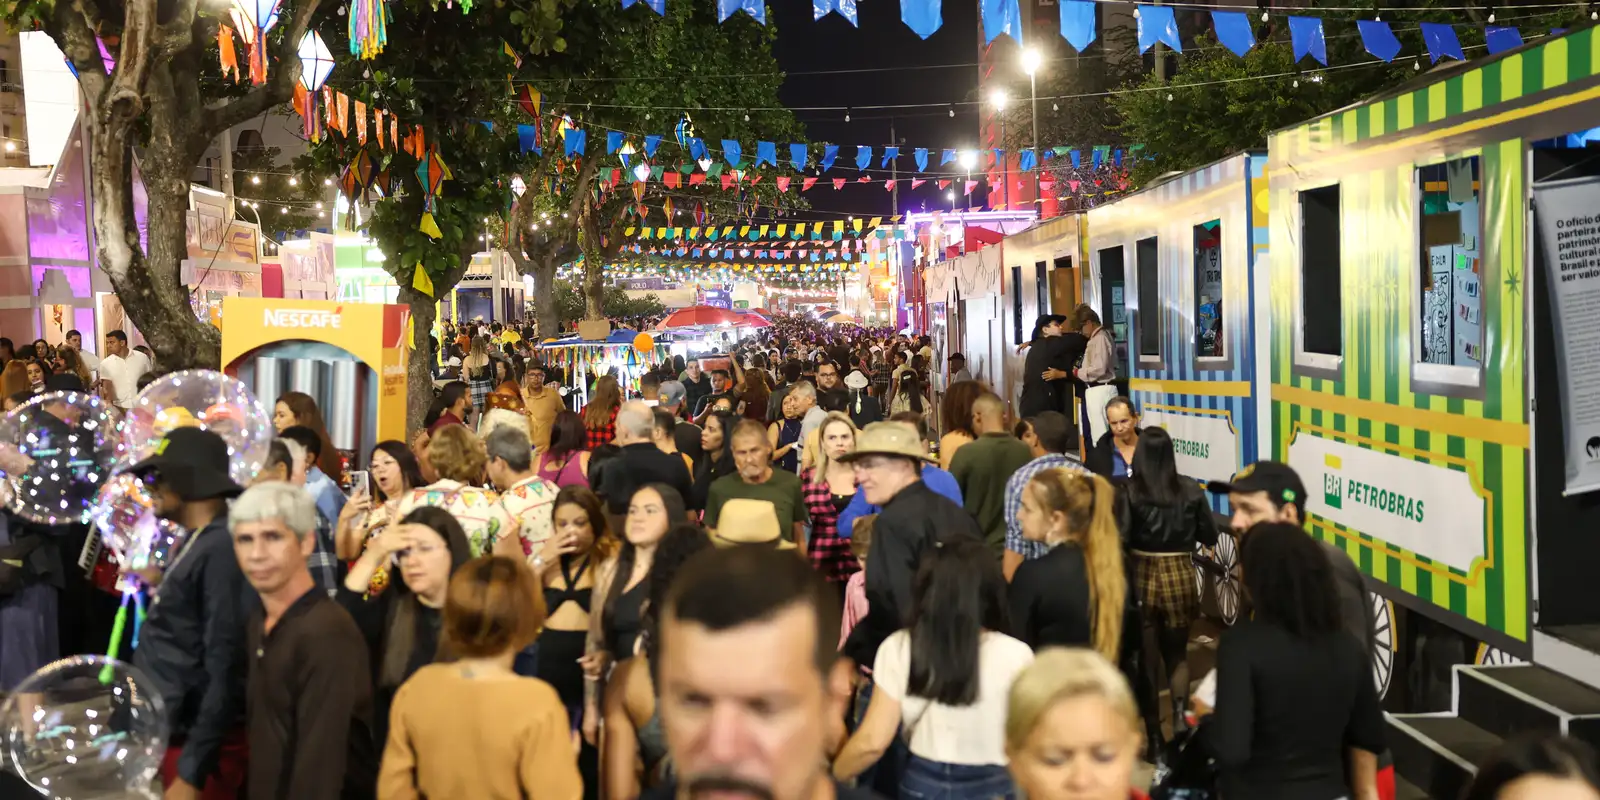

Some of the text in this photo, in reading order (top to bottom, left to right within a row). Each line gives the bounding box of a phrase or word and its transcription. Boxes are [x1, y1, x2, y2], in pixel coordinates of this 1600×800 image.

[1557, 219, 1565, 228] O
[1566, 216, 1593, 227] ofício
[1558, 227, 1596, 241] parteira
[1560, 247, 1597, 260] cultural
[1561, 259, 1588, 271] Brasil
[1562, 274, 1576, 282] ser
[264, 306, 343, 328] NESCAFÉ
[1324, 473, 1424, 523] BR PETROBRAS
